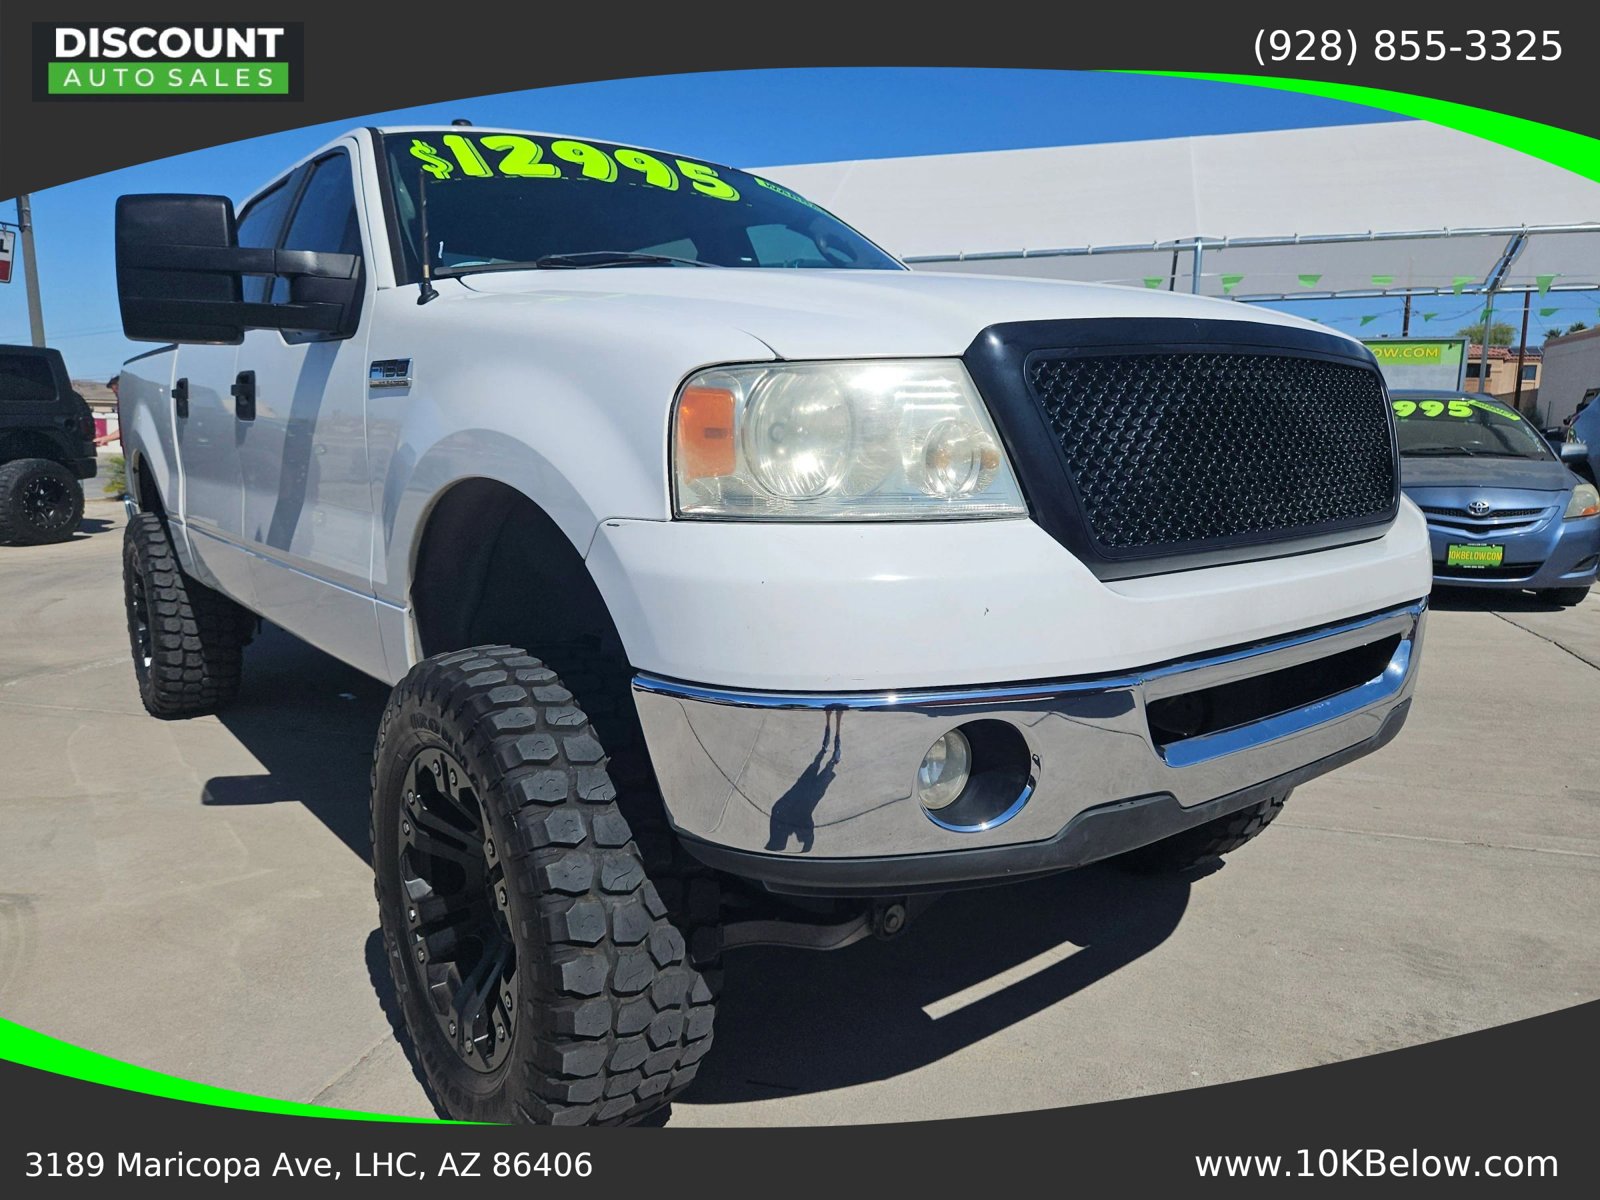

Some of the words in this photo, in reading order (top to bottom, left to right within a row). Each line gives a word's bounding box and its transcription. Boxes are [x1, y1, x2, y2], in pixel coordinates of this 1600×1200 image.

[409, 134, 740, 202] $12995
[1372, 347, 1438, 358] OW.COM
[1391, 400, 1474, 418] 995
